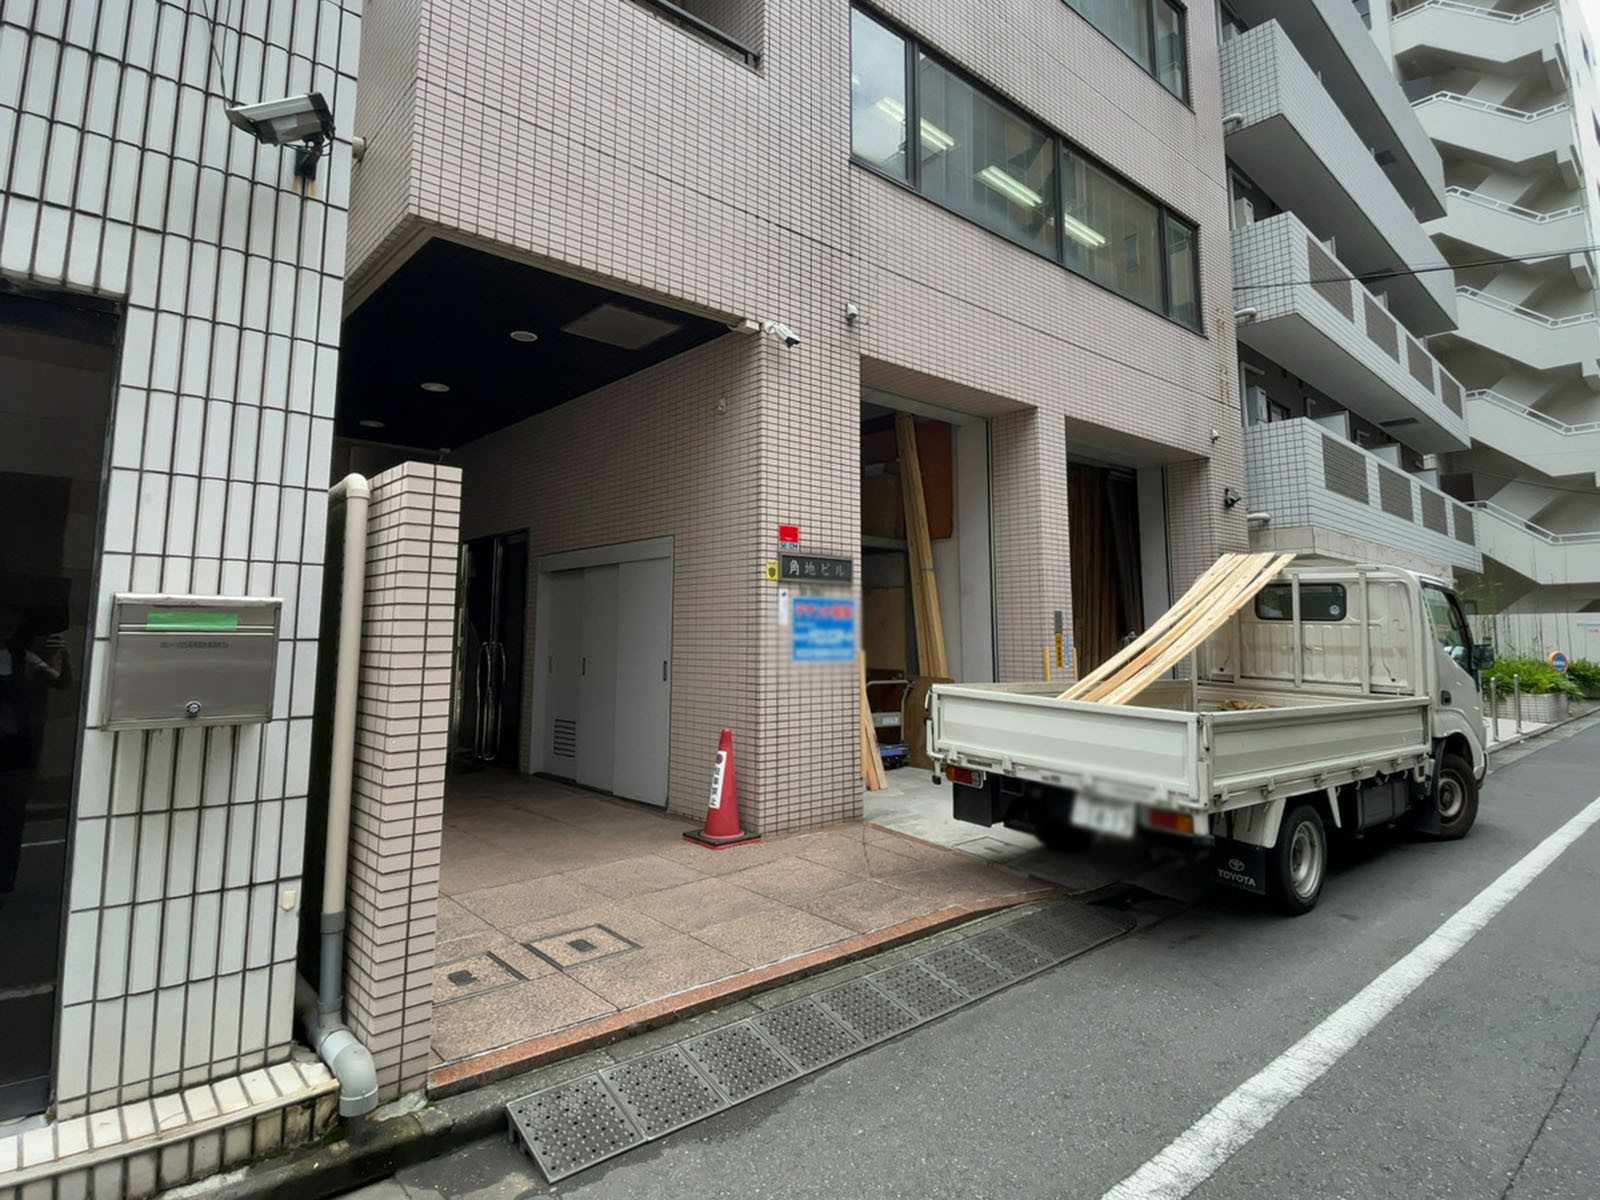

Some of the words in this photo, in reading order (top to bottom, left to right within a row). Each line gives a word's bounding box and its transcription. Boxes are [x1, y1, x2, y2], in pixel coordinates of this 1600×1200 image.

[789, 560, 846, 576] 角地ビル
[1217, 869, 1257, 887] TOYOTA
